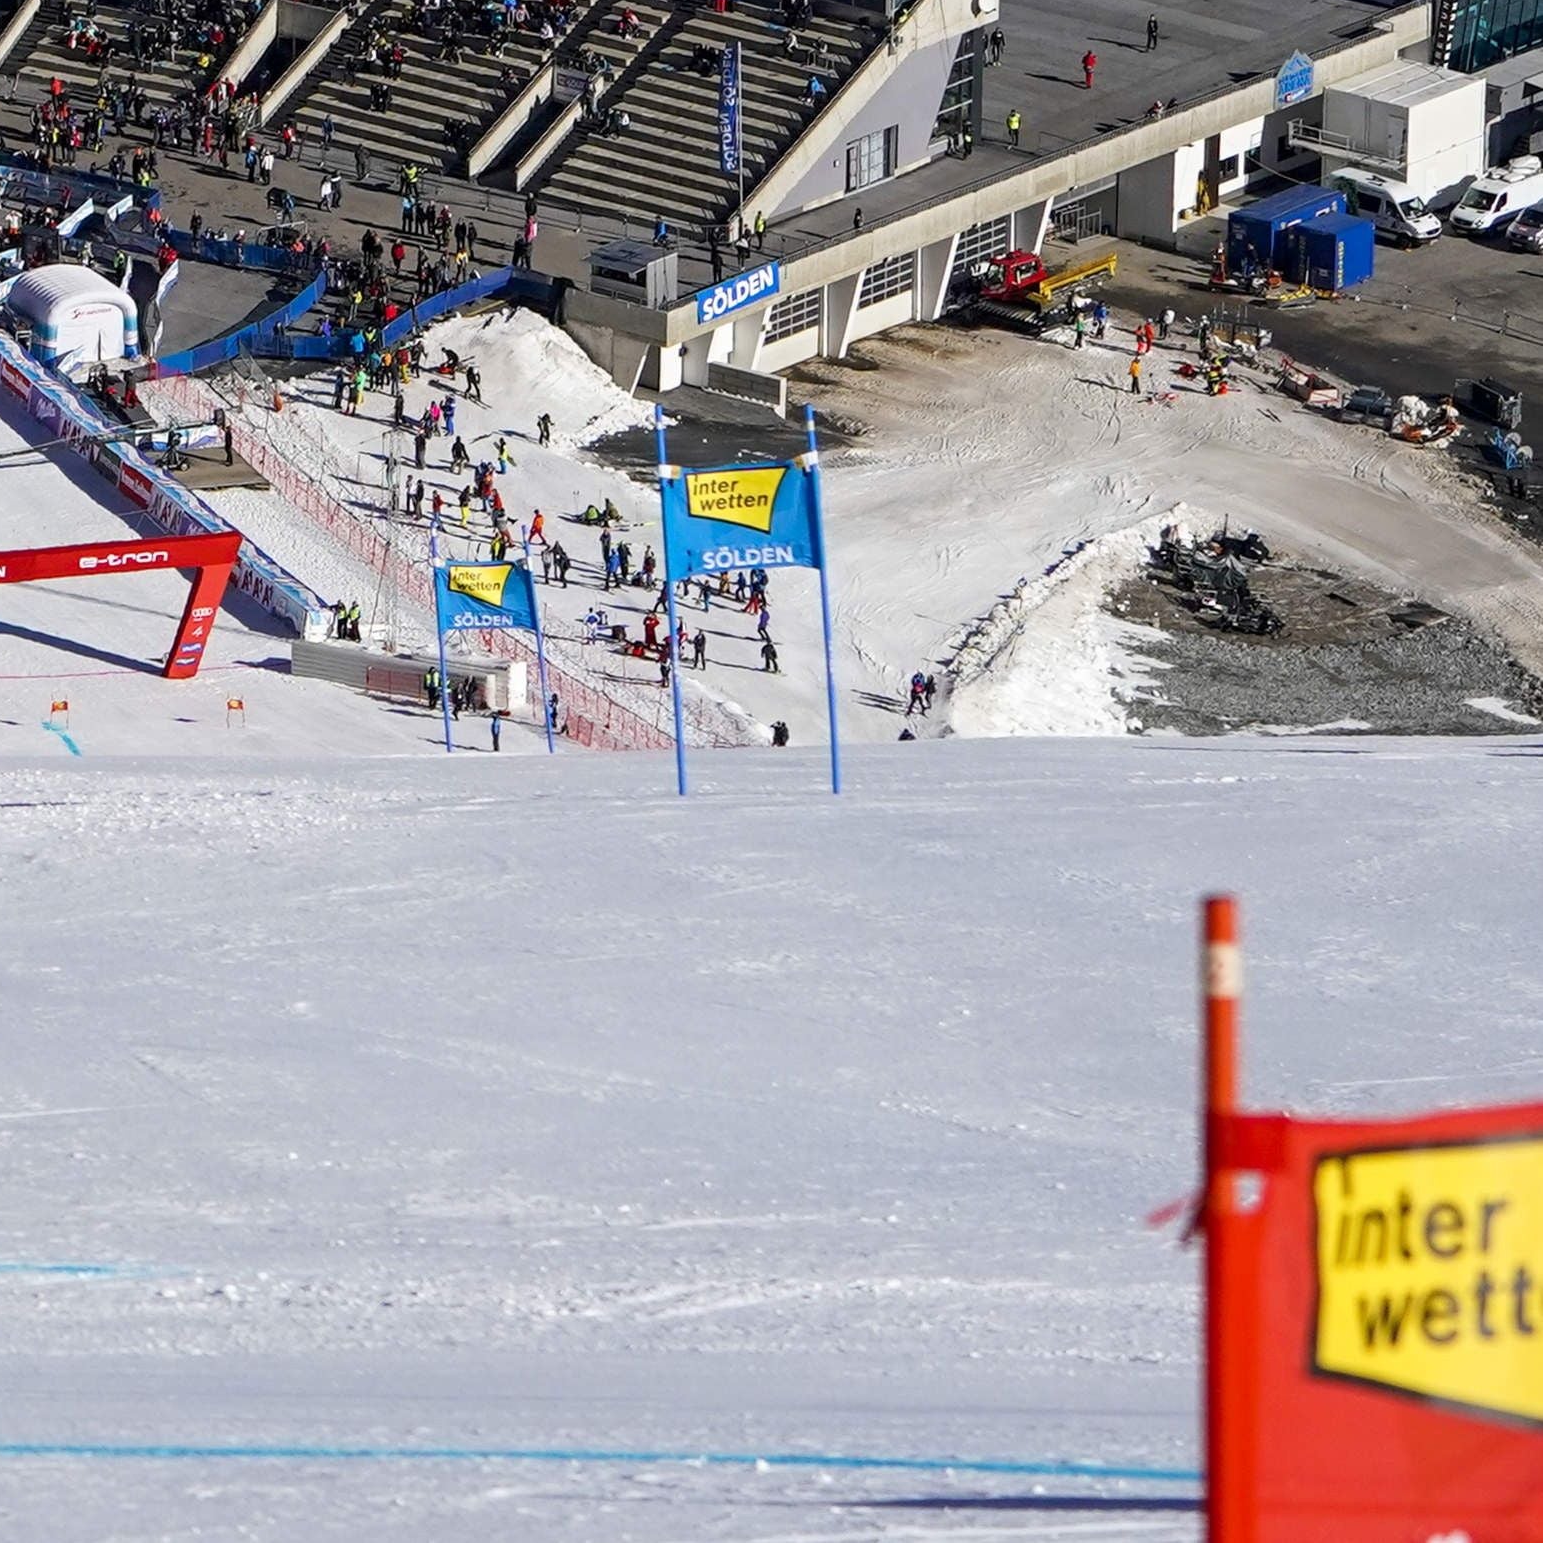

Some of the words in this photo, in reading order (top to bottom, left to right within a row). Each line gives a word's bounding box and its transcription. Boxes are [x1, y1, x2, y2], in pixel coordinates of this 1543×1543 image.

[702, 265, 775, 322] SÖLDEN
[693, 474, 739, 496] inter
[700, 493, 769, 512] wetten
[79, 550, 169, 569] e-tron
[702, 546, 795, 570] SÖLDEN
[453, 567, 483, 582] inter
[456, 581, 502, 592] wetten
[454, 611, 514, 627] SÖLDEN
[1335, 1158, 1508, 1266] inter
[1357, 1266, 1543, 1348] wett
